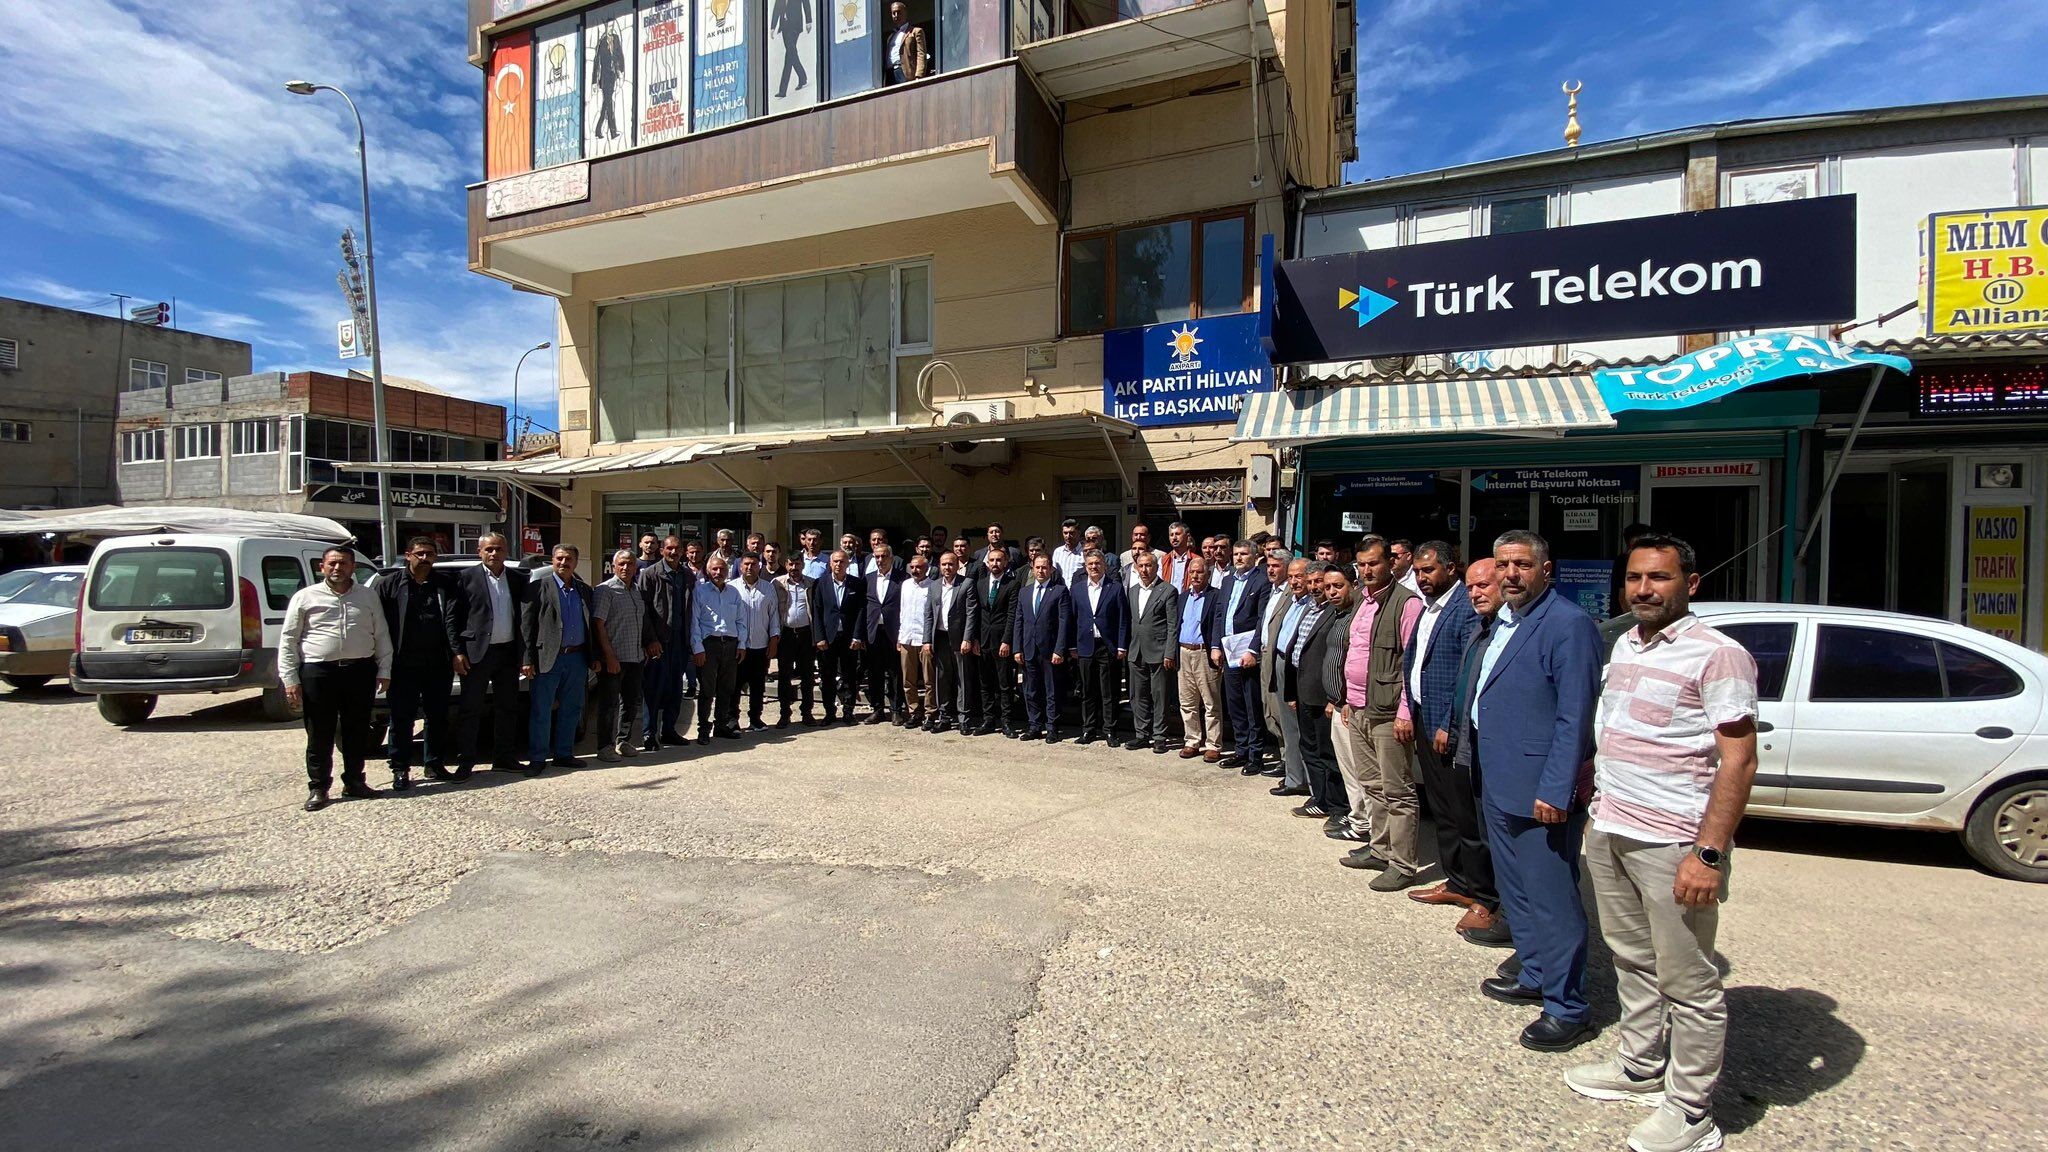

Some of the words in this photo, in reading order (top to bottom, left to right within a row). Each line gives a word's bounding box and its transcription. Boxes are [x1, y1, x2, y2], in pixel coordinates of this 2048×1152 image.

[707, 29, 716, 39] AK
[1946, 211, 2028, 252] MİM
[1408, 276, 1515, 320] Türk
[1531, 255, 1763, 308] Telekom
[1606, 334, 1858, 386] TOPRAK
[1114, 380, 1138, 397] AK
[1142, 371, 1192, 394] PARTİ
[1197, 368, 1262, 390] HİLVAN
[1667, 364, 1753, 401] Telekom
[1114, 401, 1150, 420] İLÇE
[1154, 390, 1254, 417] BAŞKANL
[1485, 479, 1528, 490] İnternet
[1530, 479, 1575, 490] Başvuru
[1577, 478, 1622, 488] Noktası
[1516, 471, 1540, 480] Türk
[1542, 470, 1589, 479] Telekom
[1550, 494, 1590, 506] Toprak
[1976, 517, 2017, 539] KASKO
[1975, 552, 2016, 578] TRAFİK
[1973, 592, 2017, 615] YANGIN
[133, 630, 145, 640] 63
